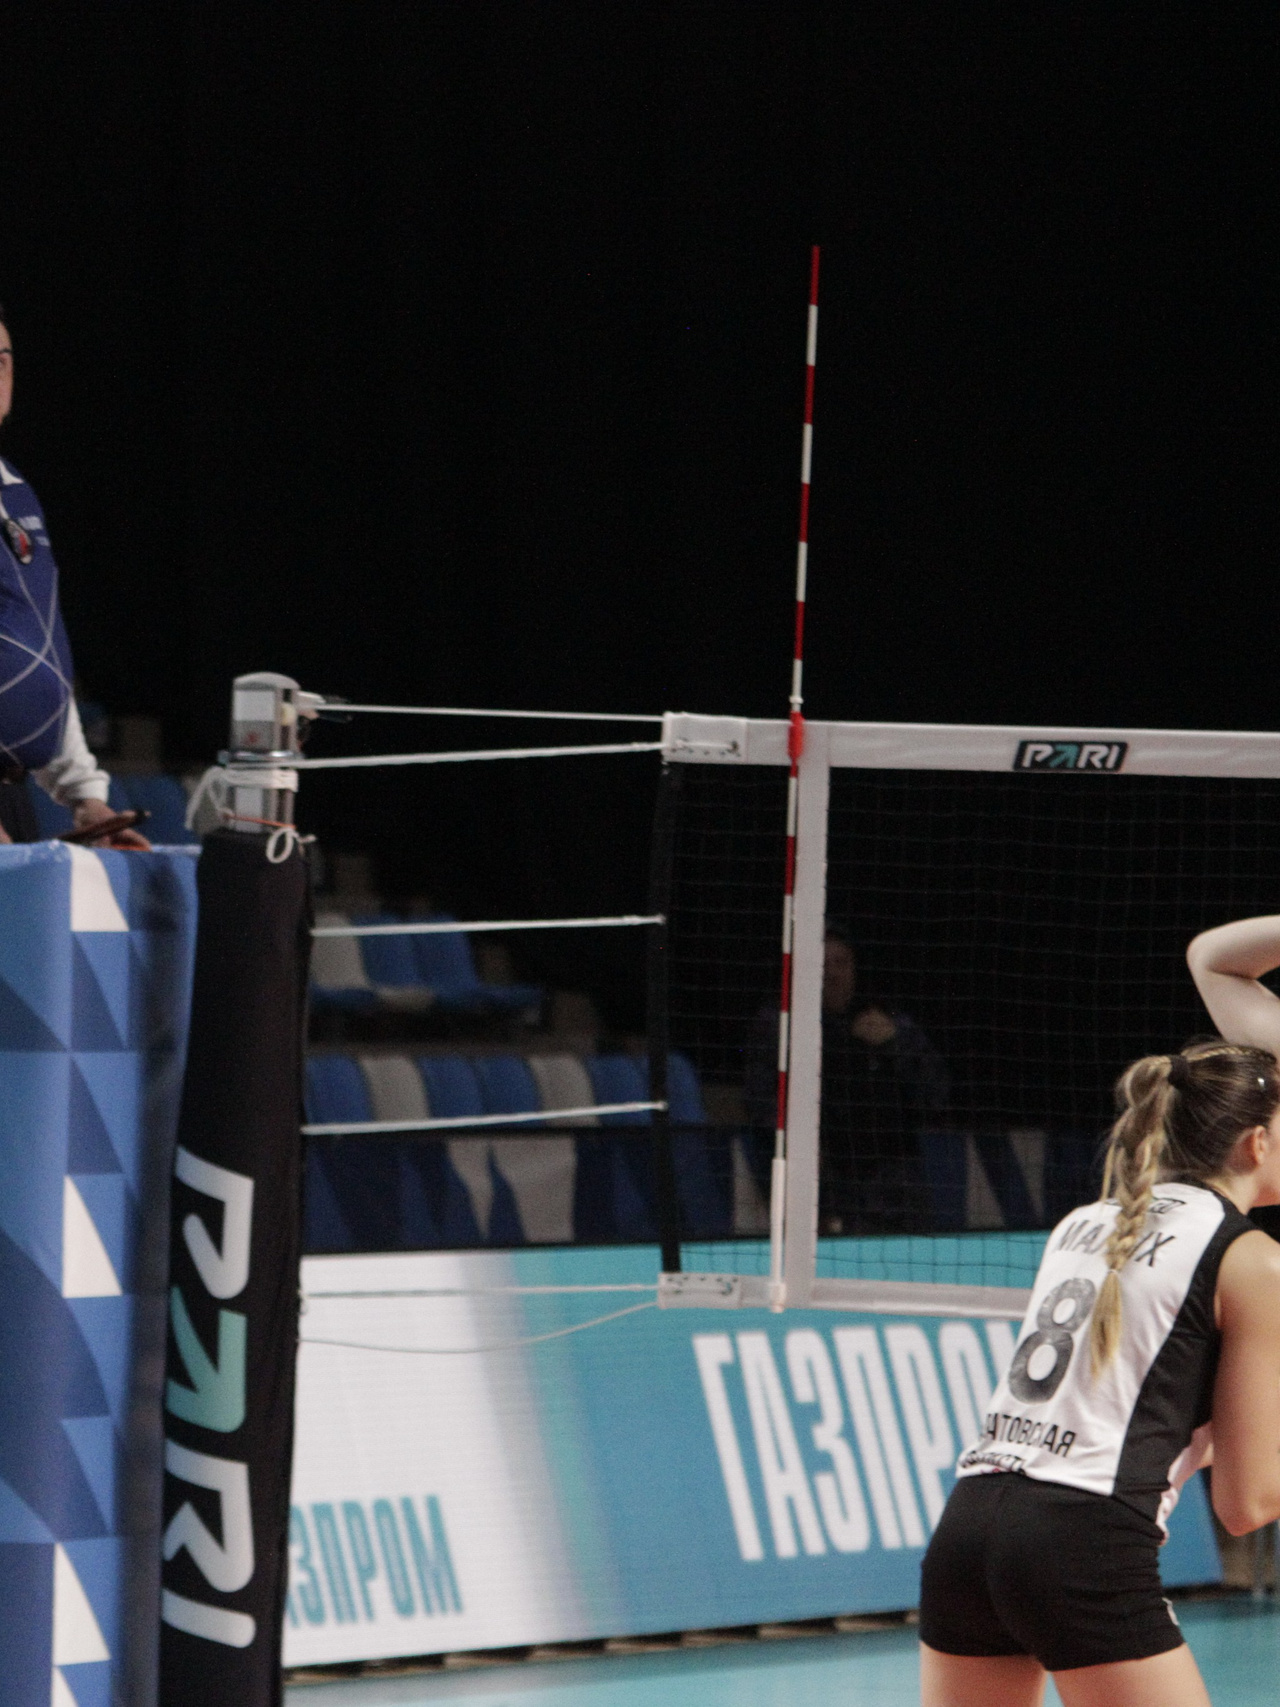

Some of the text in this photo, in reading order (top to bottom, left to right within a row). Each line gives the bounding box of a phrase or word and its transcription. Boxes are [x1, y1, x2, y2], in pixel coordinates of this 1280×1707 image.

[1021, 743, 1121, 770] PARI
[161, 1145, 256, 1649] PARI
[1008, 1277, 1097, 1405] 8
[691, 1321, 1020, 1562] ГАЗПРО
[286, 1493, 464, 1628] ЗПРОМ
